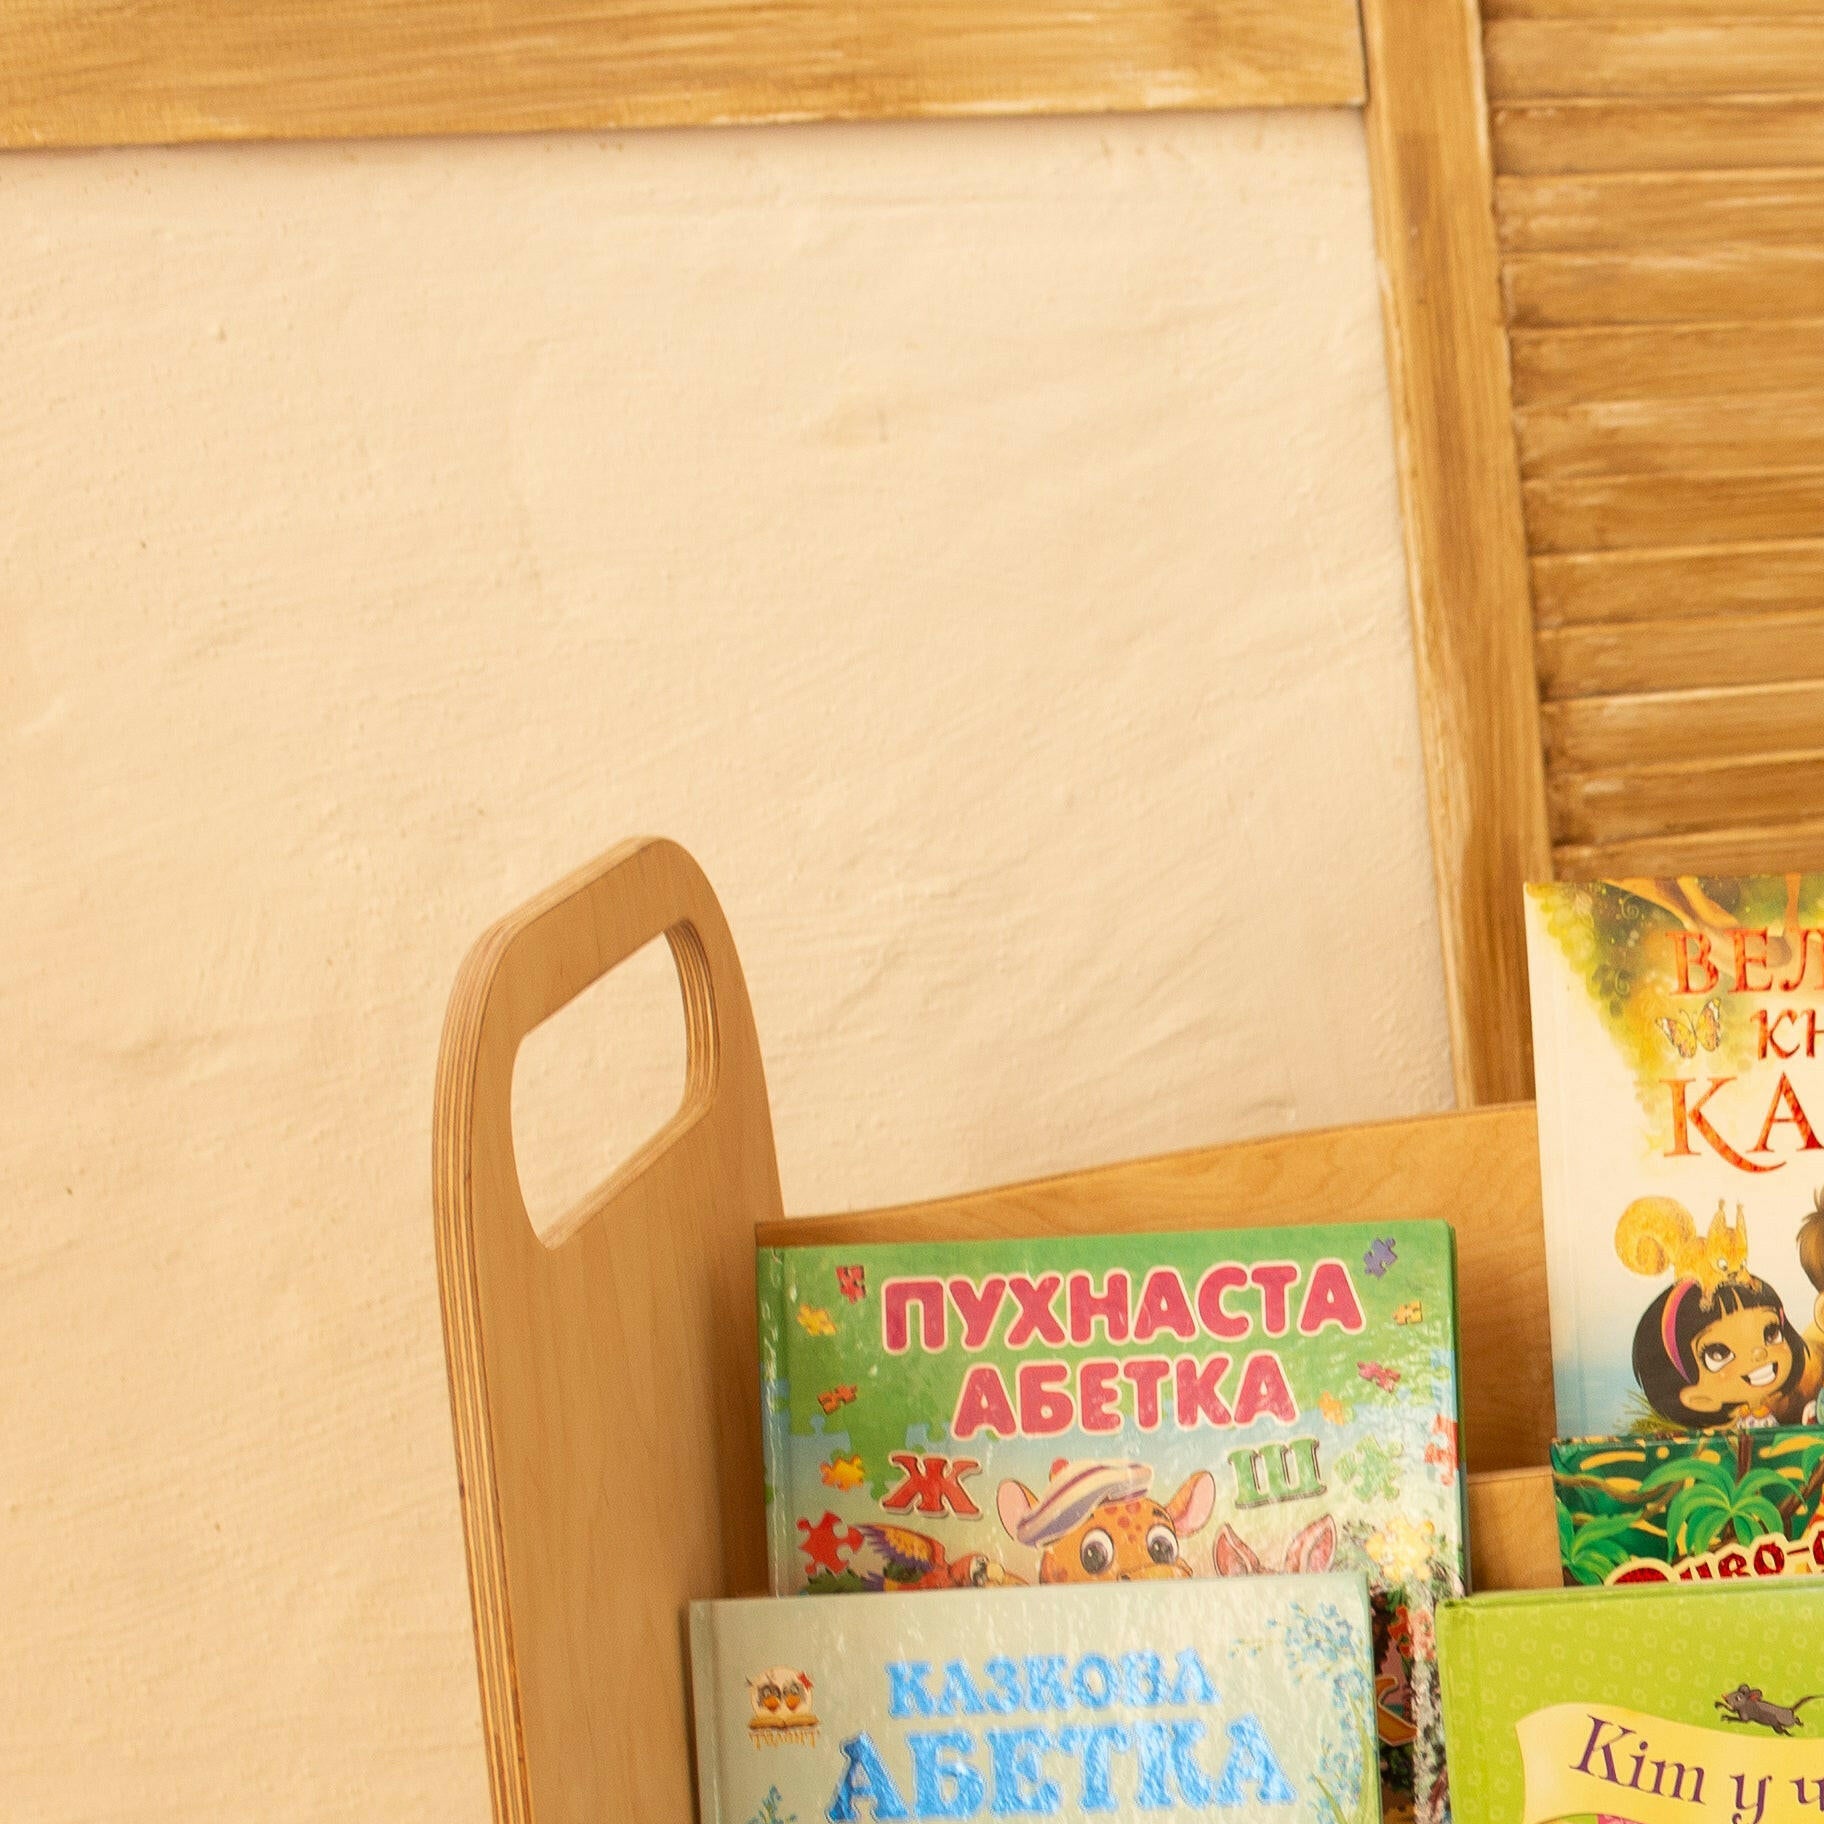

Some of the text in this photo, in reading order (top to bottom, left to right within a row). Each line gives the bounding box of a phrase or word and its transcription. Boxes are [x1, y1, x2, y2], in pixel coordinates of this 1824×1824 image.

[881, 1258, 1366, 1354] ПУХНАСТА
[951, 1350, 1300, 1440] АБЕТКА
[882, 1454, 983, 1520] Ж
[1227, 1438, 1327, 1508] Ш
[885, 1647, 1220, 1720] КАЗКОВА
[1570, 1714, 1706, 1806] Кіт
